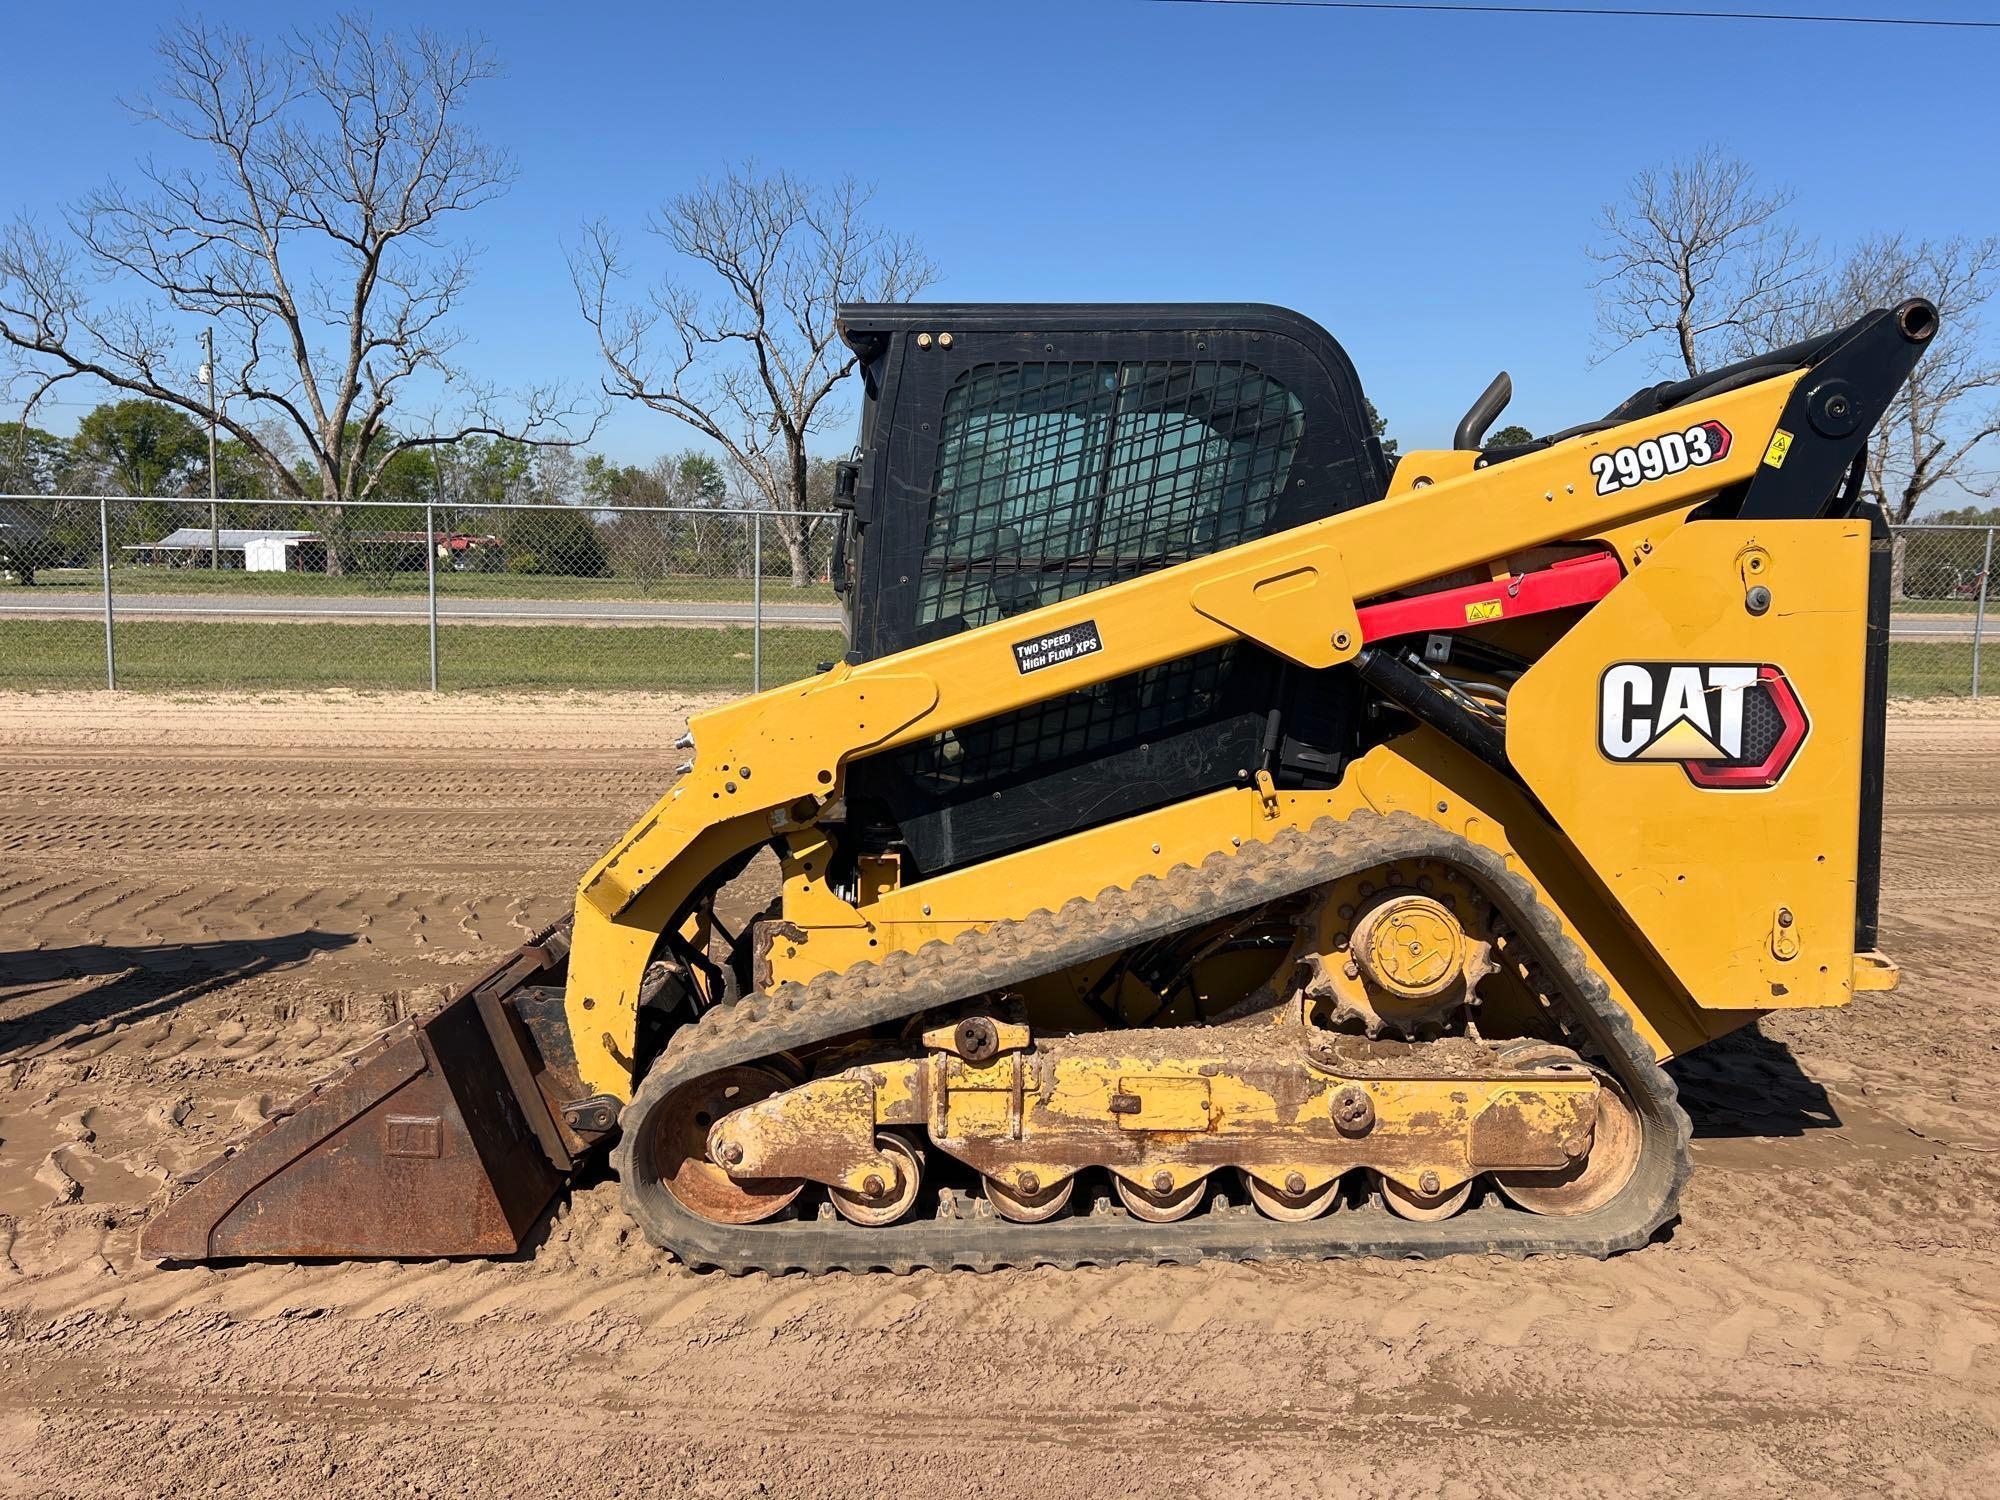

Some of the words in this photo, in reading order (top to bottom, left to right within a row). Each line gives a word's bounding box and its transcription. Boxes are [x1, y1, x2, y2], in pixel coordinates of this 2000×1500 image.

[1592, 426, 1712, 494] 299D3
[1017, 643, 1039, 657] TWO
[1041, 633, 1071, 651] SPEED
[1022, 656, 1046, 671] HIGH
[1048, 646, 1074, 663] FLOW
[1076, 638, 1097, 654] XPS
[1602, 664, 1758, 759] CAT
